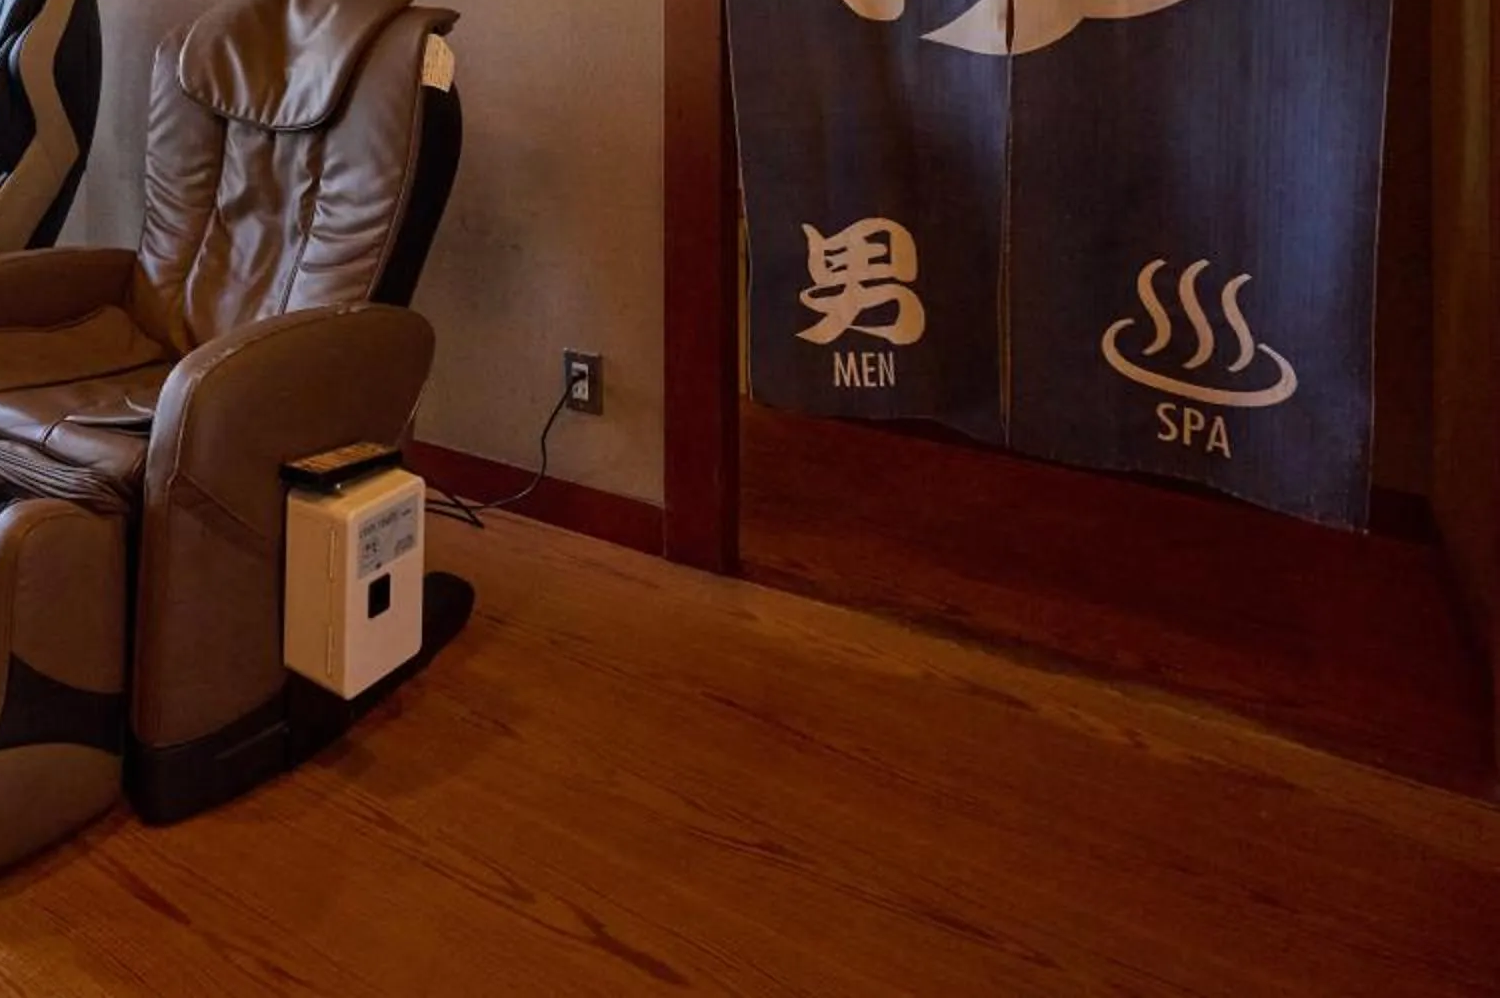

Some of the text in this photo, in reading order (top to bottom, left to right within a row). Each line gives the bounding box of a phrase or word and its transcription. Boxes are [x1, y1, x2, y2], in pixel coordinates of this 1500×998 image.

[795, 216, 925, 345] 男
[833, 352, 895, 387] MEN
[1155, 402, 1232, 459] SPA
